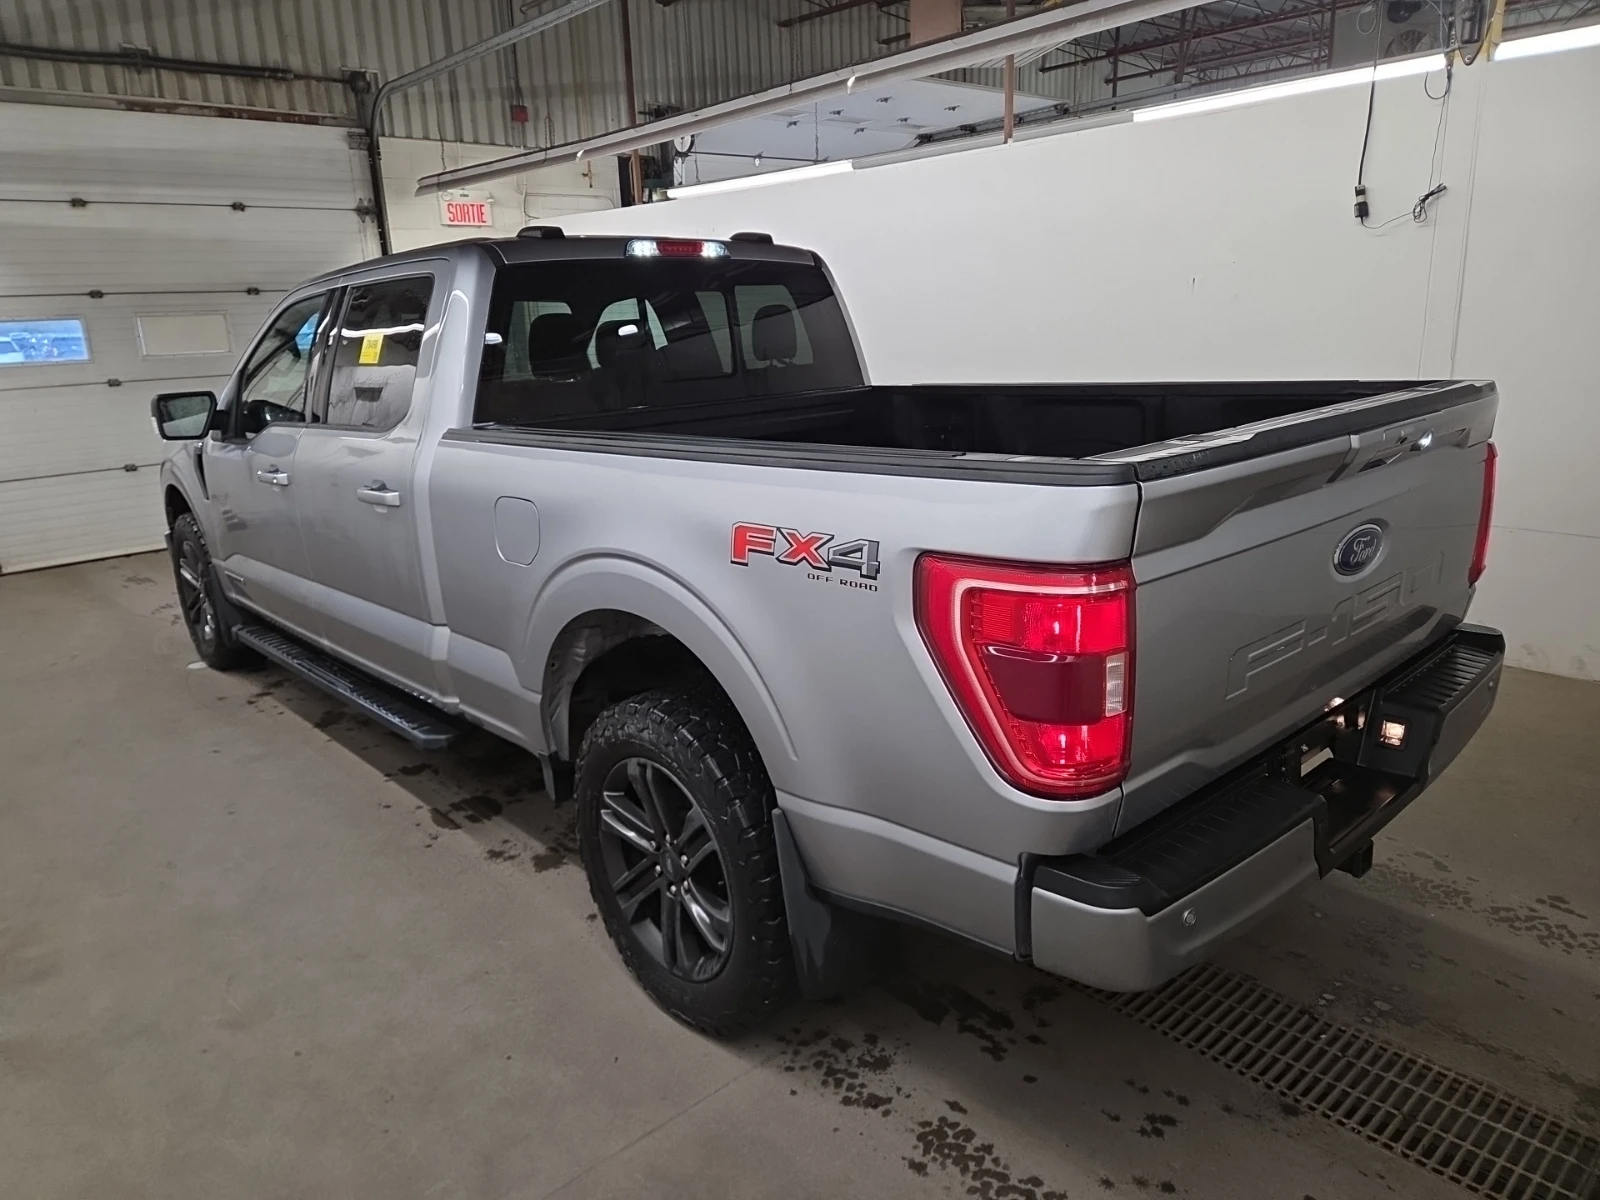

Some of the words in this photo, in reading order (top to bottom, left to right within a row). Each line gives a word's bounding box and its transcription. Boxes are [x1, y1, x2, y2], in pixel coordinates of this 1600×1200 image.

[447, 202, 487, 223] SORTIE
[730, 521, 880, 581] FX4
[1349, 535, 1378, 565] Ford
[807, 572, 834, 583] OFF
[839, 578, 878, 592] ROAD
[1225, 550, 1444, 700] F-150
